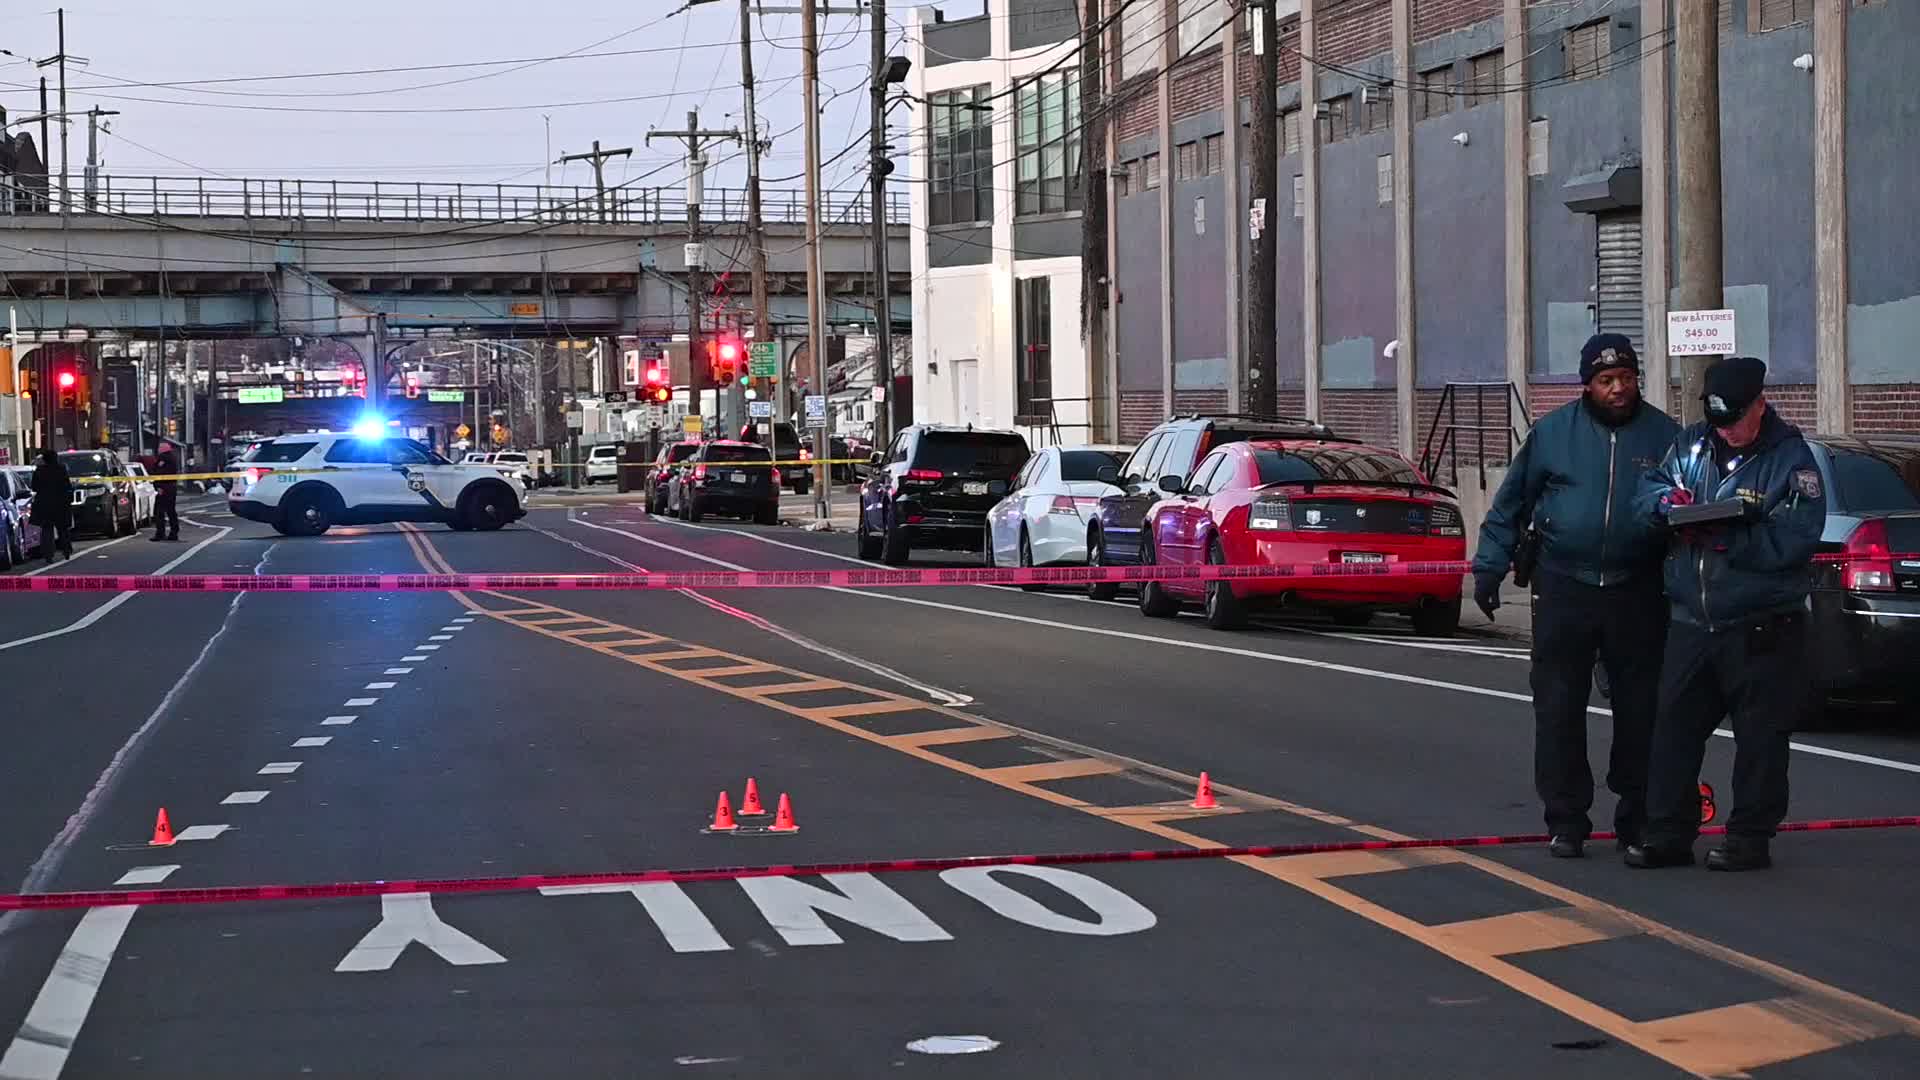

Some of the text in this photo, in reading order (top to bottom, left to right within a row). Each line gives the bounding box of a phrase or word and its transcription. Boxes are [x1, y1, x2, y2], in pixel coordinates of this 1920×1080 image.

[1671, 314, 1733, 323] NEW BATTERIES
[1685, 328, 1718, 337] $45.00
[1671, 343, 1733, 353] 267-319-9202
[1204, 786, 1209, 795] 2
[749, 793, 756, 802] 5
[720, 807, 728, 816] 3
[158, 824, 166, 832] 4
[335, 865, 1157, 973] ONLY
